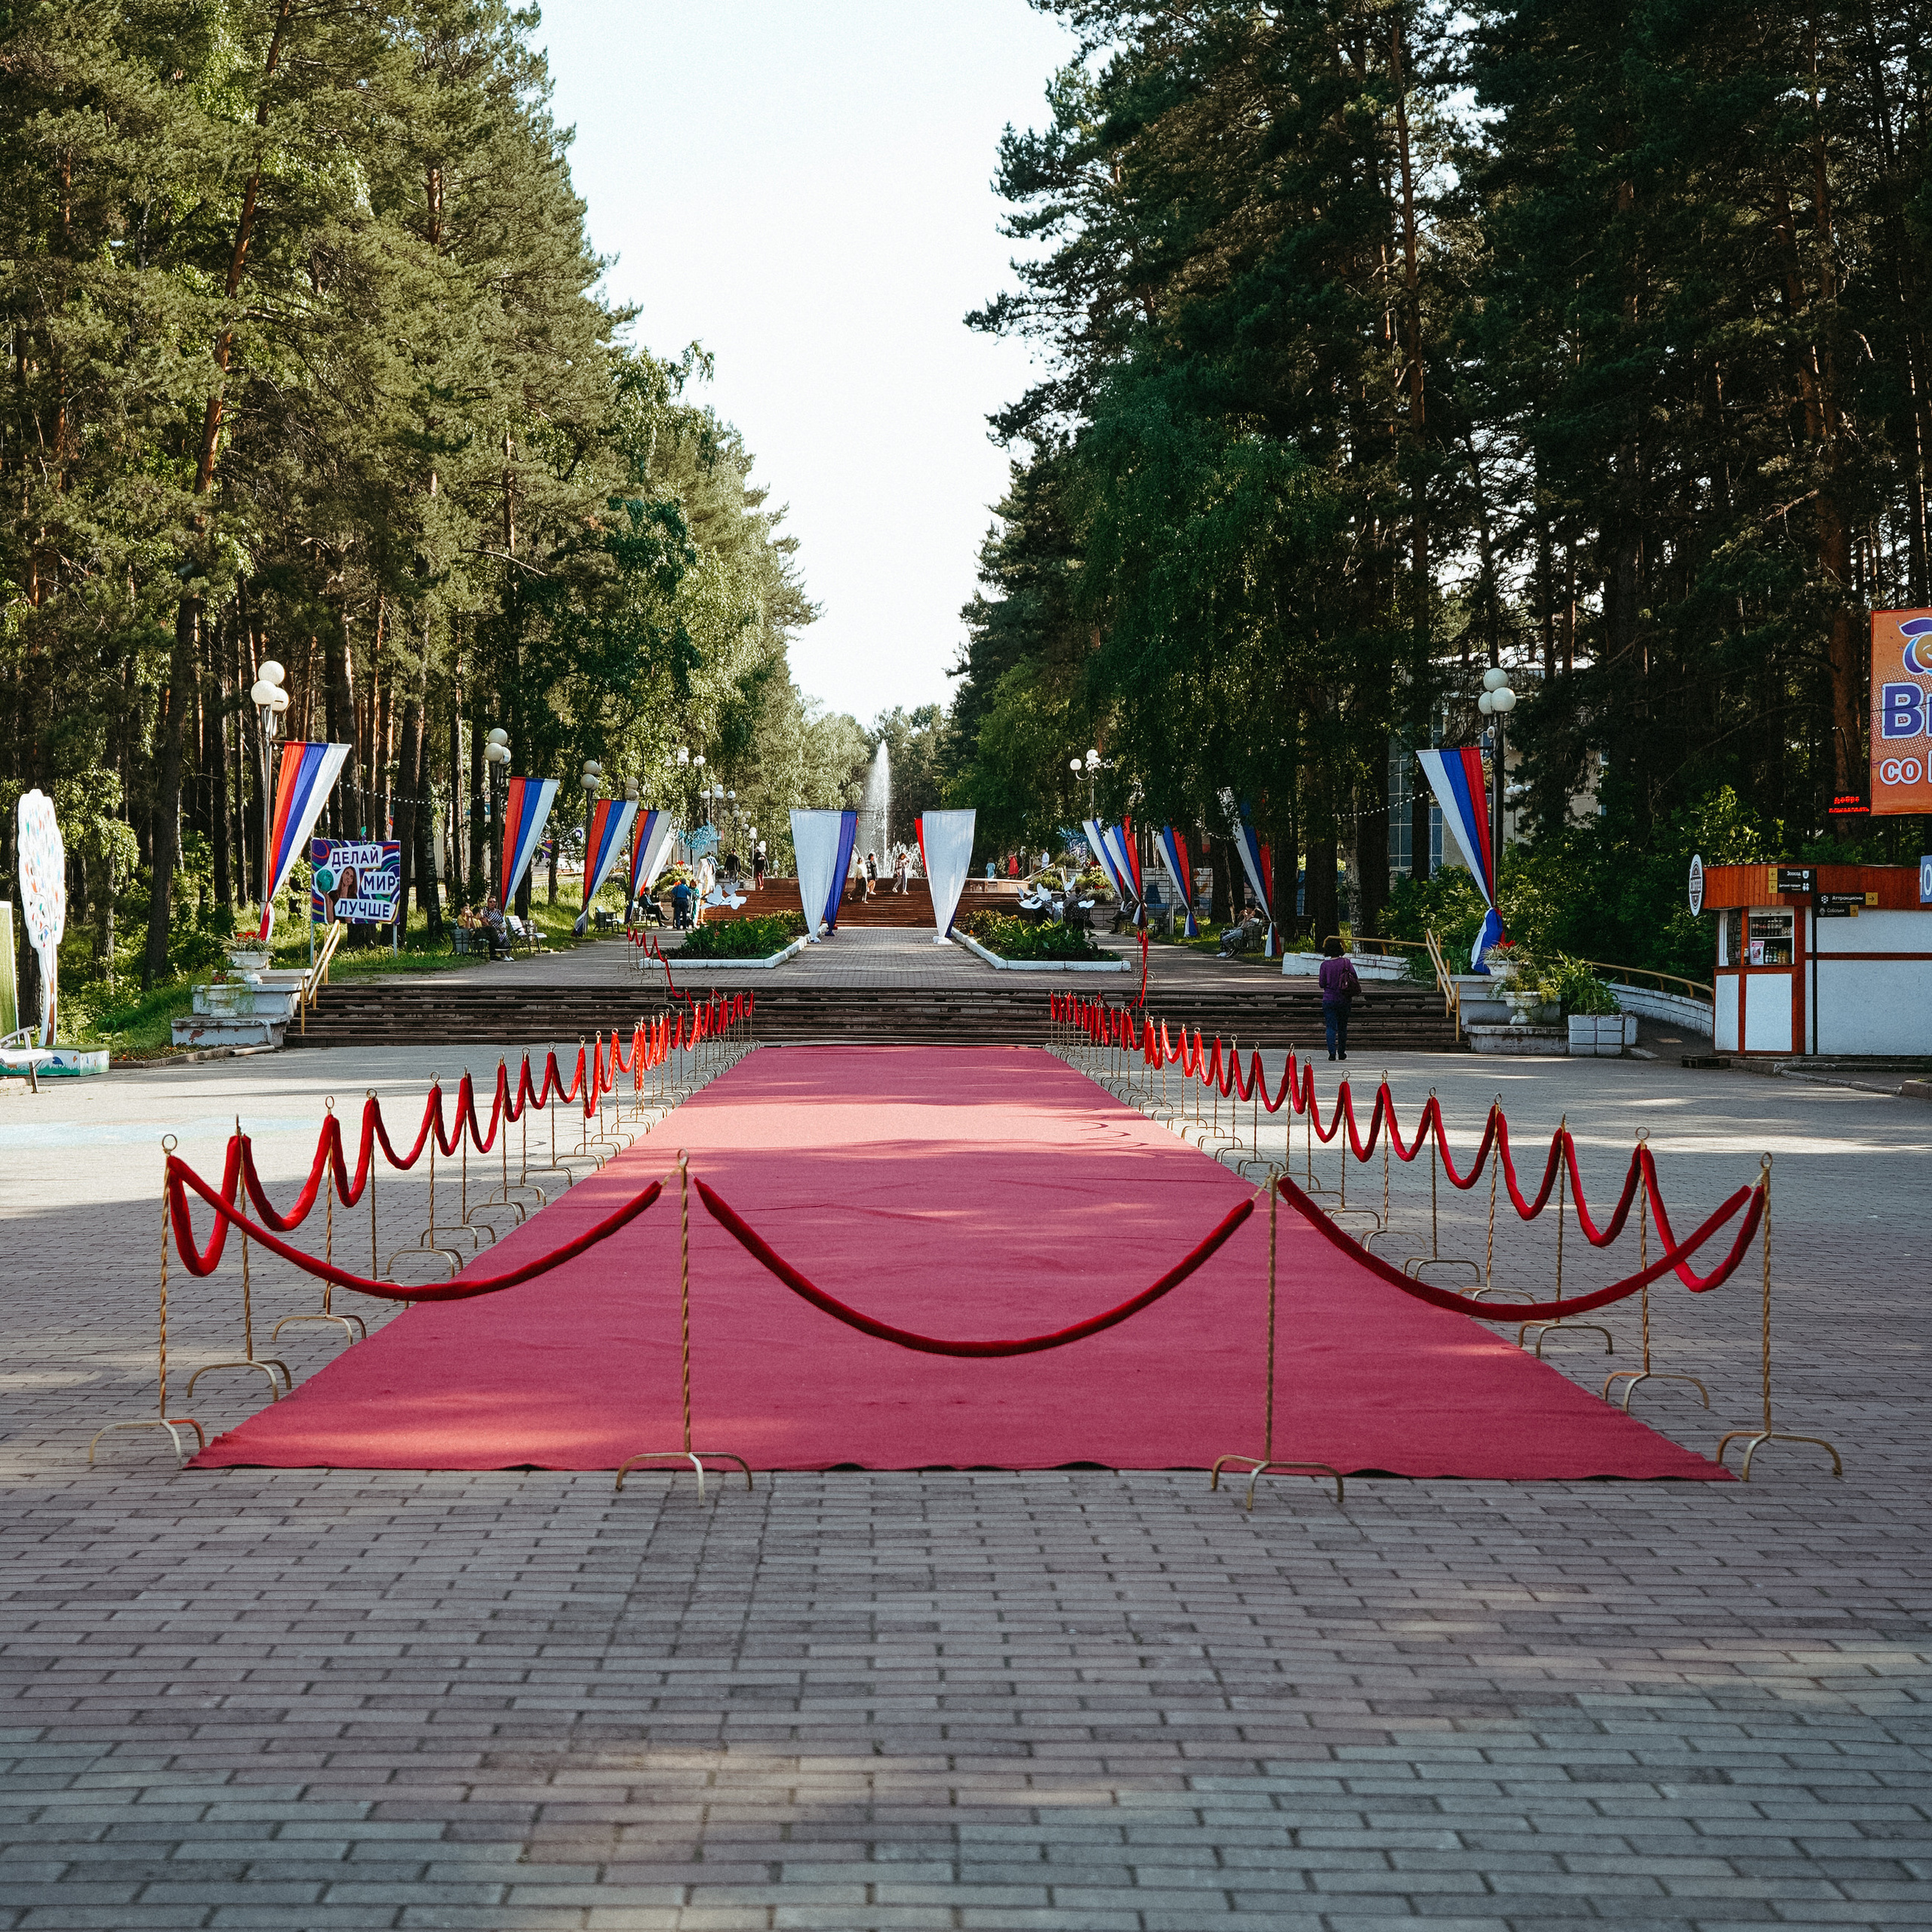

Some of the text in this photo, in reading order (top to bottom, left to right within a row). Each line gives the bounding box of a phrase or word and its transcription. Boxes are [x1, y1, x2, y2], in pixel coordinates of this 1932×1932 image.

[1881, 682, 1932, 739] В
[332, 846, 379, 867] ДЕЛАЙ
[364, 875, 396, 891] МИР
[338, 900, 390, 918] ЛУЧШЕ
